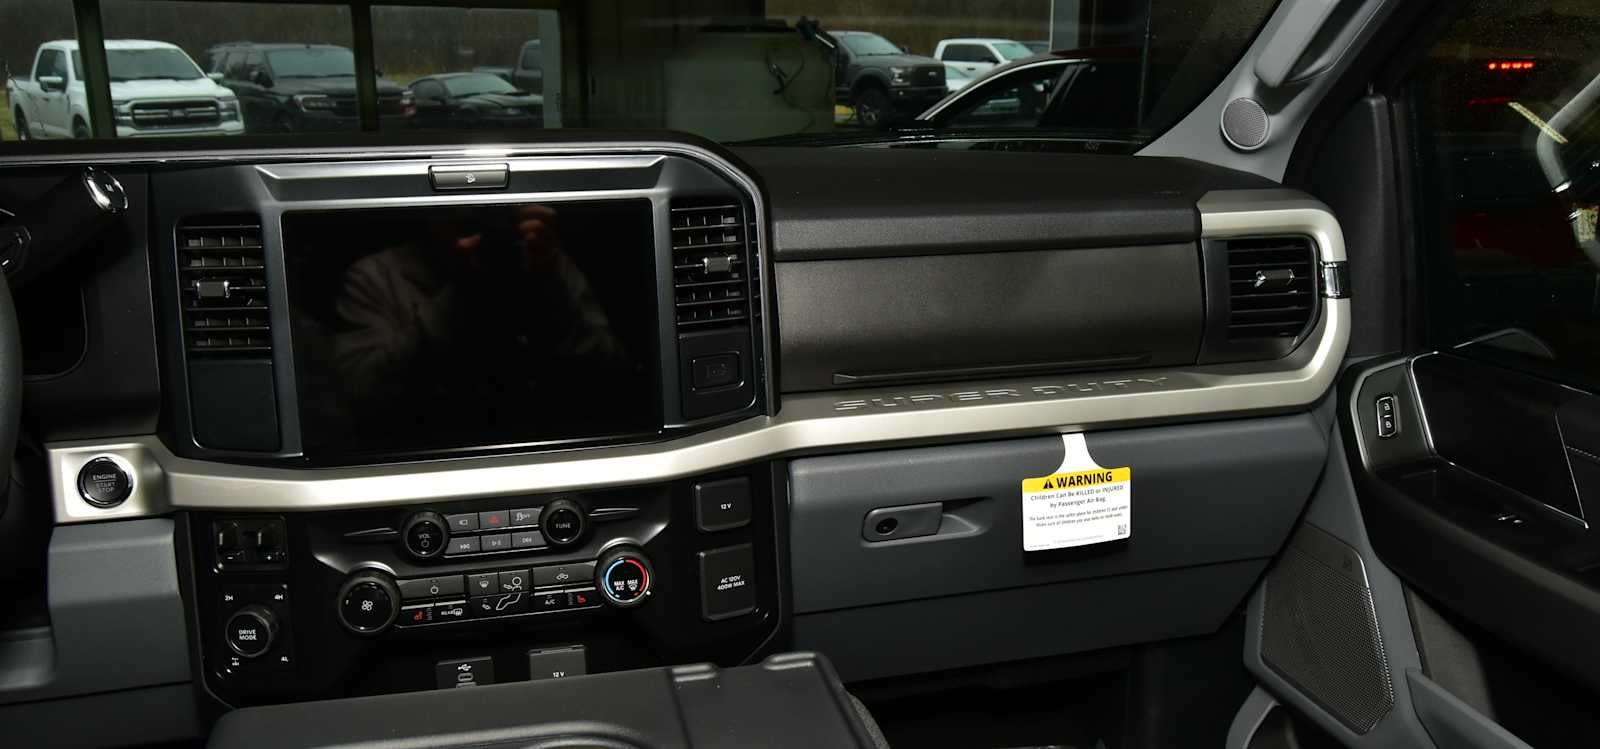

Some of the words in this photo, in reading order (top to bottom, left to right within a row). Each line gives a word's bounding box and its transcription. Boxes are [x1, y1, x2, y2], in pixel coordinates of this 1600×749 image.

[833, 388, 1022, 411] SUPER
[1031, 376, 1169, 395] DUTY
[1056, 472, 1112, 488] WARNING
[1102, 484, 1124, 493] INJURED
[1058, 499, 1086, 507] Passenger
